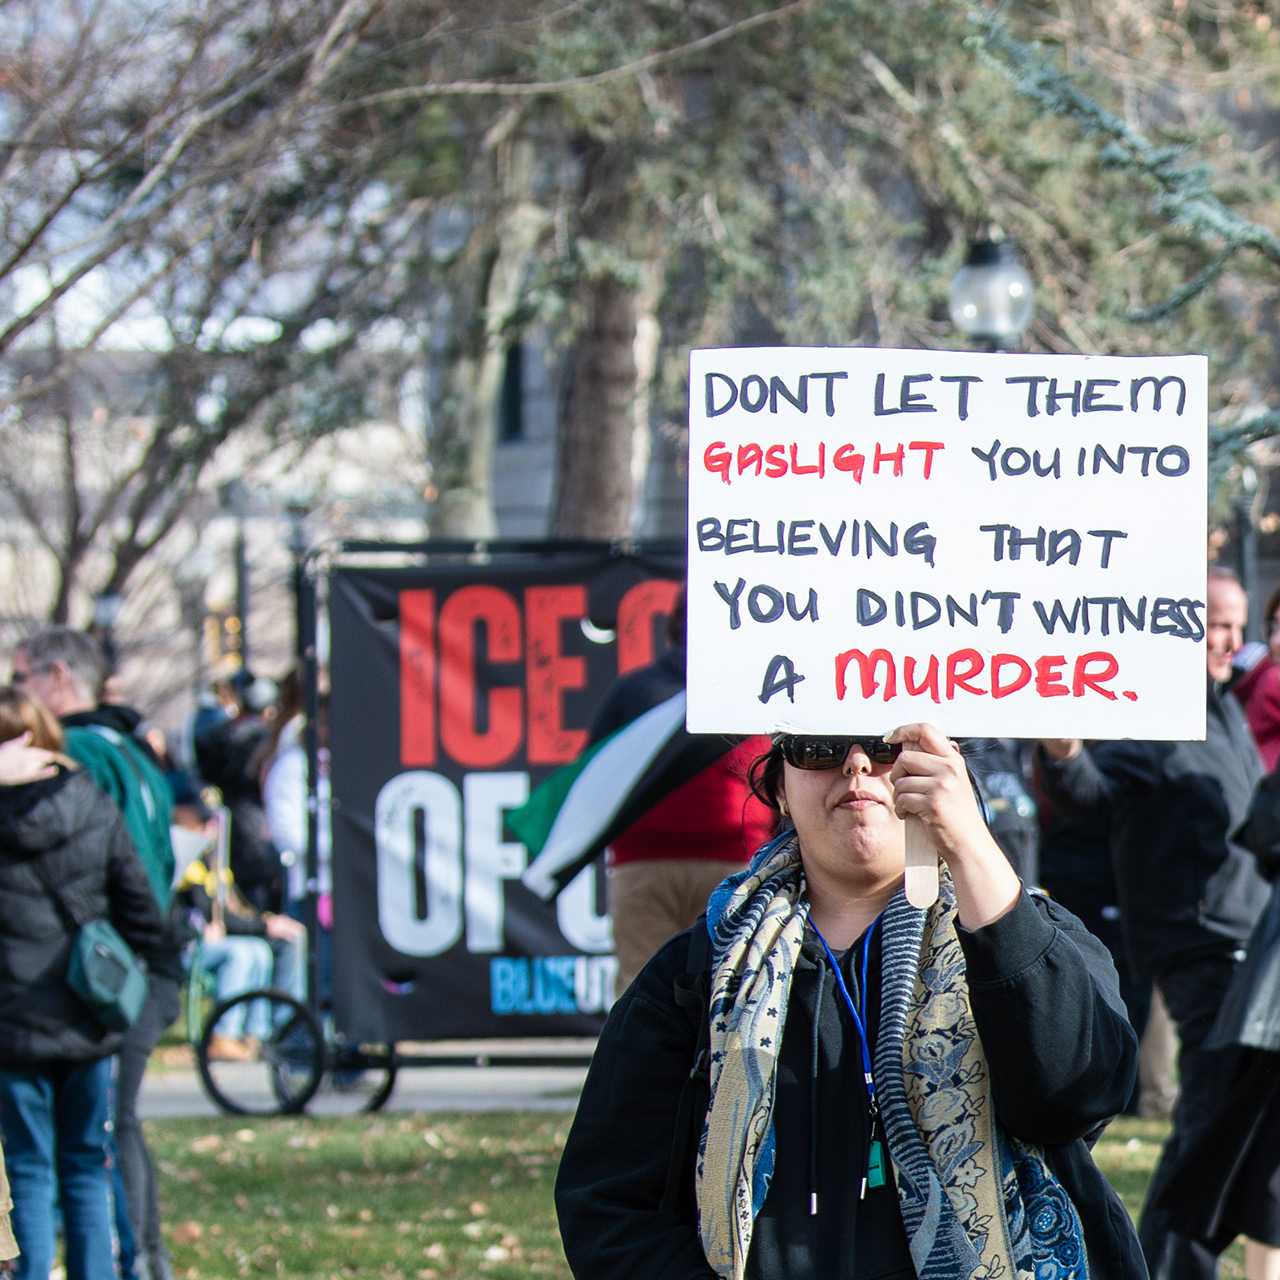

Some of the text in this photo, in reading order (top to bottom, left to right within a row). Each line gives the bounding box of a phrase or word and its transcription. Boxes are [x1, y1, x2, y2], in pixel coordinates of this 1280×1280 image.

[704, 371, 1186, 421] DONT LET THEM
[703, 439, 1190, 484] GASLIGHT YOU INTO
[696, 517, 1128, 569] BELIEVING THAT
[713, 577, 819, 630] YOU
[856, 588, 1021, 634] DIDN'T
[1033, 595, 1205, 643] WITNESS
[398, 584, 588, 767] ICE
[758, 648, 1139, 704] A MURDER.
[374, 770, 530, 957] OF
